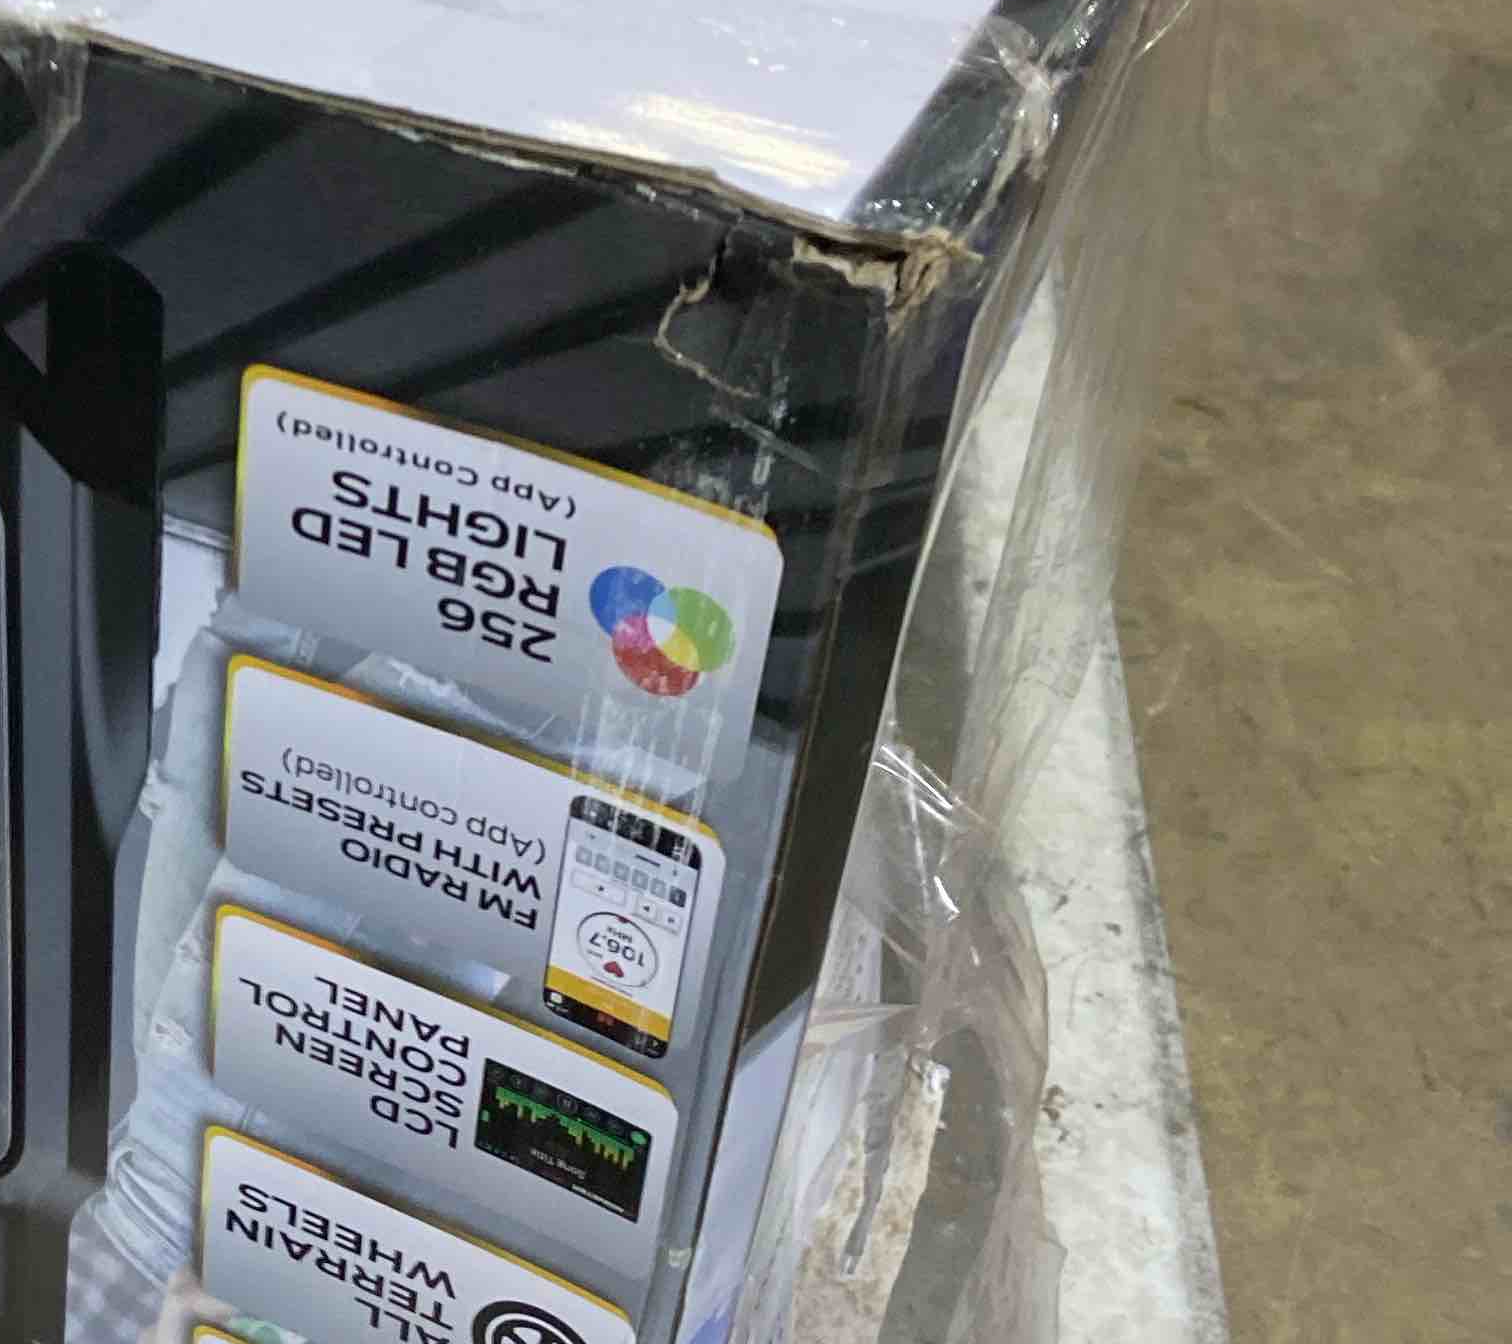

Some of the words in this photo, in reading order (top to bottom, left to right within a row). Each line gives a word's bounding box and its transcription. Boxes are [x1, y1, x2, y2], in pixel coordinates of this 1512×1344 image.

[275, 410, 479, 488] Controlled)
[331, 469, 567, 571] LIGHTS
[492, 474, 576, 520] (App
[291, 506, 409, 569] LED
[427, 547, 561, 619] RGB
[437, 596, 557, 663] 256
[241, 770, 423, 852] PRESETS
[281, 746, 458, 826] controlled)
[341, 836, 469, 904] RADIO
[434, 849, 542, 901] WITH
[465, 816, 547, 865] (App
[478, 892, 538, 930] FM
[588, 932, 646, 968] 106.7
[238, 976, 468, 1088] CONTROL
[315, 976, 470, 1057] PANEL
[275, 1023, 462, 1118] SCREEN
[369, 1094, 460, 1150] LCD
[224, 1208, 454, 1334] TERRAIN
[237, 1183, 456, 1300] WHEELS
